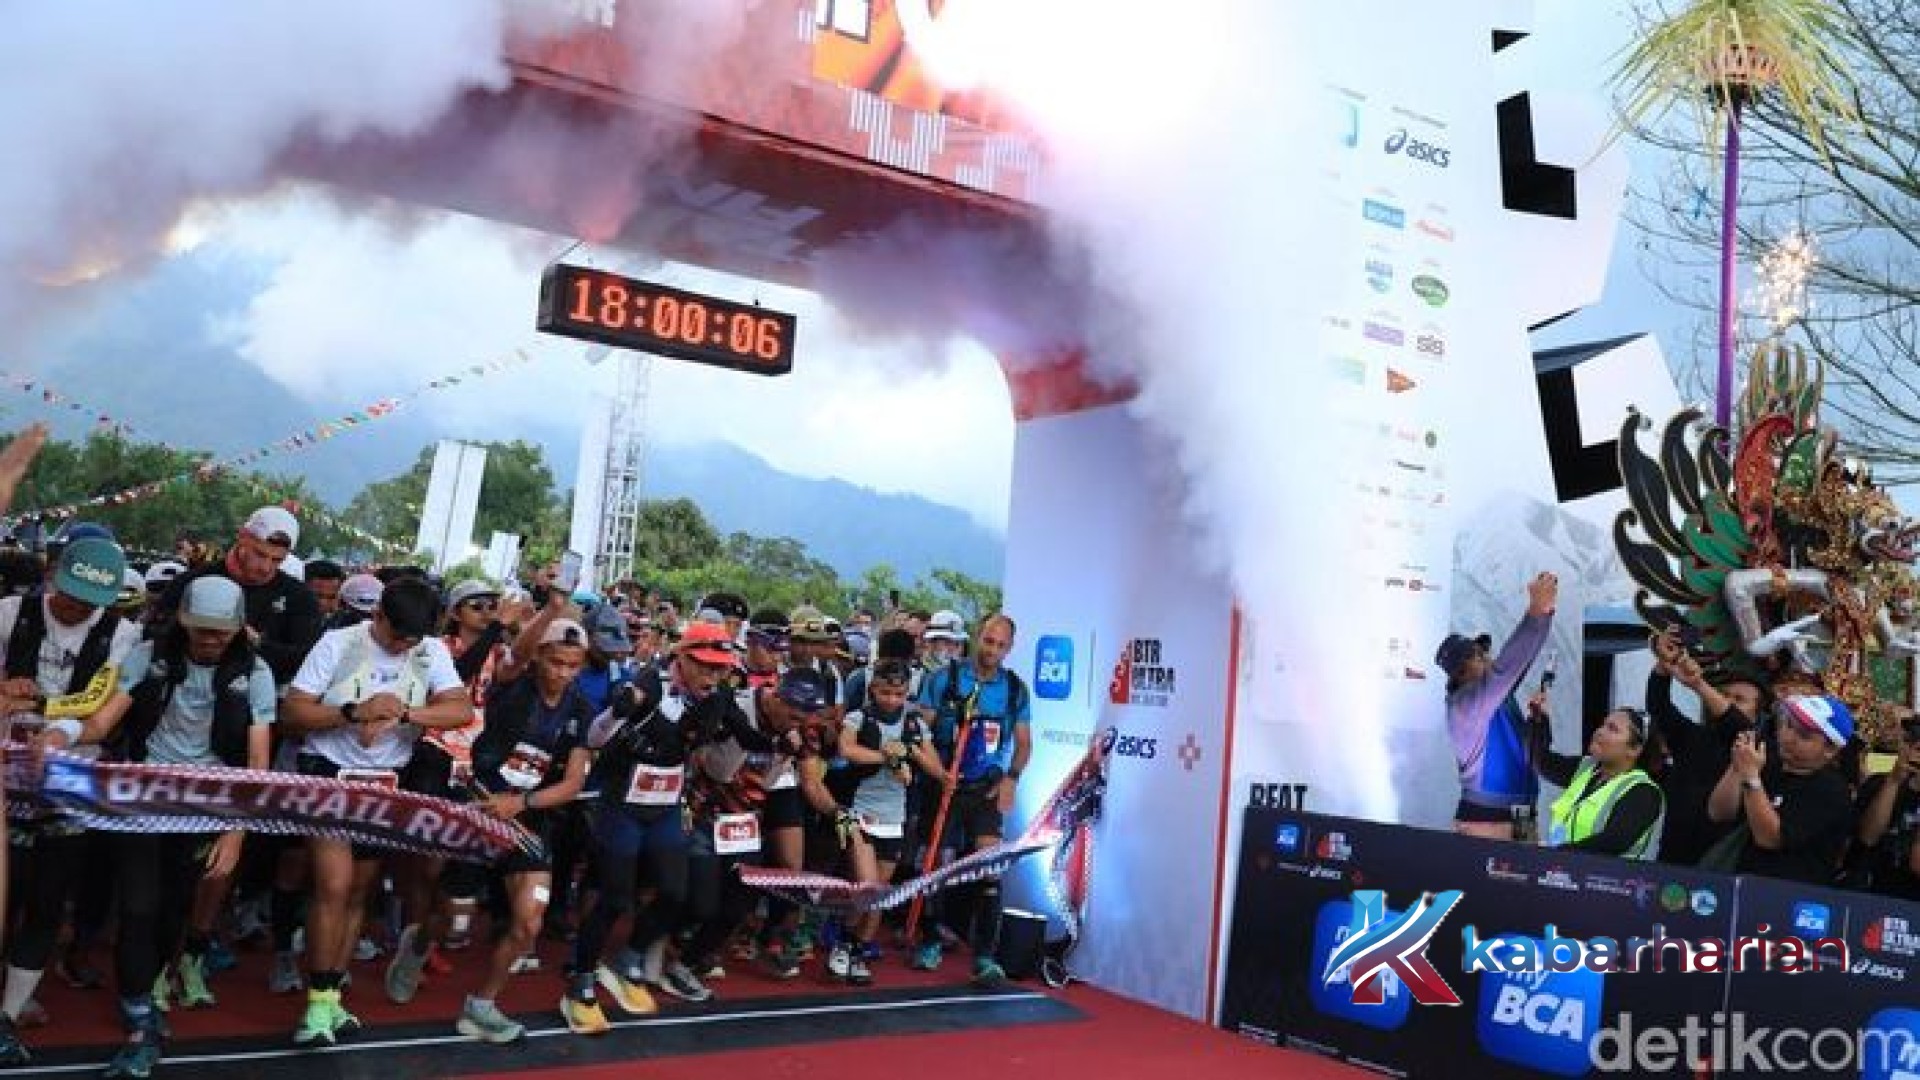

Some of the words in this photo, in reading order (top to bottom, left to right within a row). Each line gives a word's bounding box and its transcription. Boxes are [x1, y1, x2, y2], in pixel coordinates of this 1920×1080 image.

[570, 278, 781, 361] 18:00:06
[1116, 735, 1158, 759] asics
[255, 783, 393, 828] TRAIL
[1492, 984, 1584, 1042] BCA
